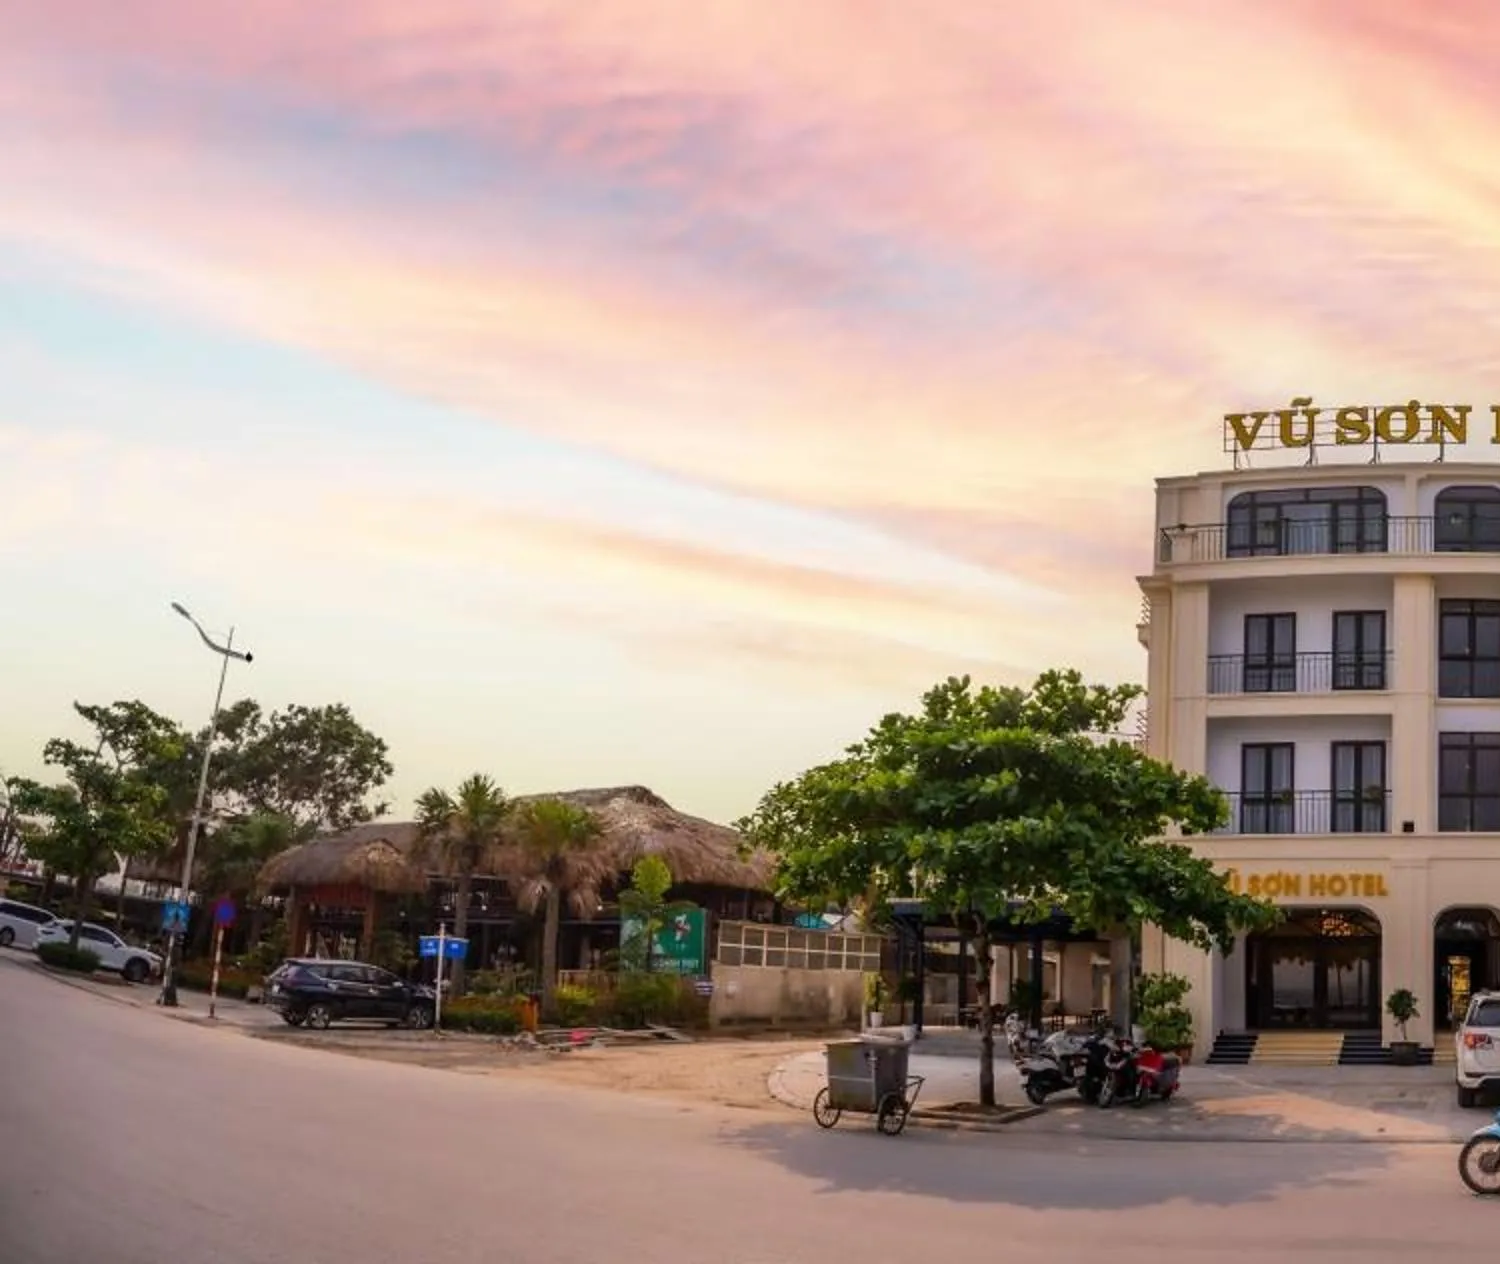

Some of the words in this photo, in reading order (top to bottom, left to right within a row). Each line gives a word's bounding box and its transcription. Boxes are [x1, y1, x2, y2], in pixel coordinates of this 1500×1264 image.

[1226, 396, 1319, 450] VŨ
[1335, 399, 1472, 446] SƠN
[1248, 869, 1300, 897] SƠN
[1309, 872, 1388, 897] HOTEL
